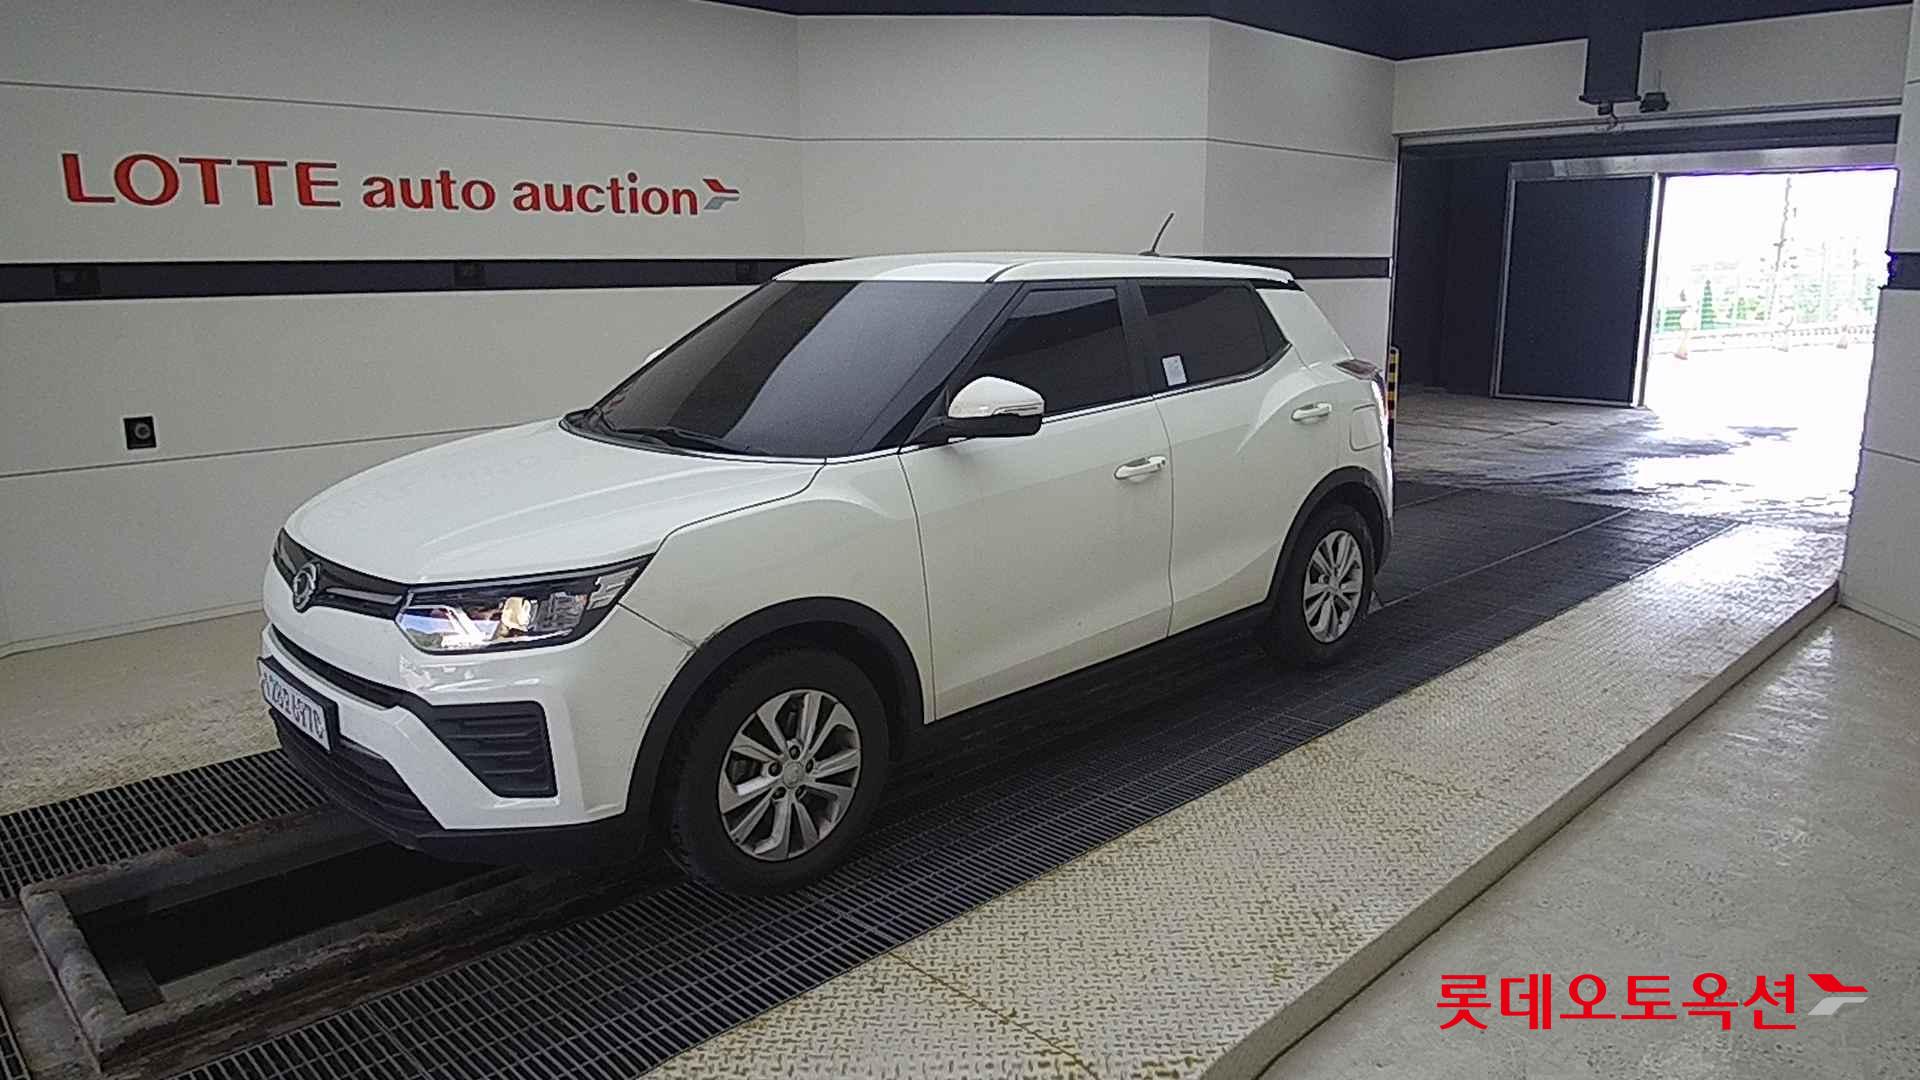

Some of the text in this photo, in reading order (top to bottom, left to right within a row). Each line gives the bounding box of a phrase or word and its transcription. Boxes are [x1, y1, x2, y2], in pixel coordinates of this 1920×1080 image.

[62, 153, 699, 216] LOTTE auto auction
